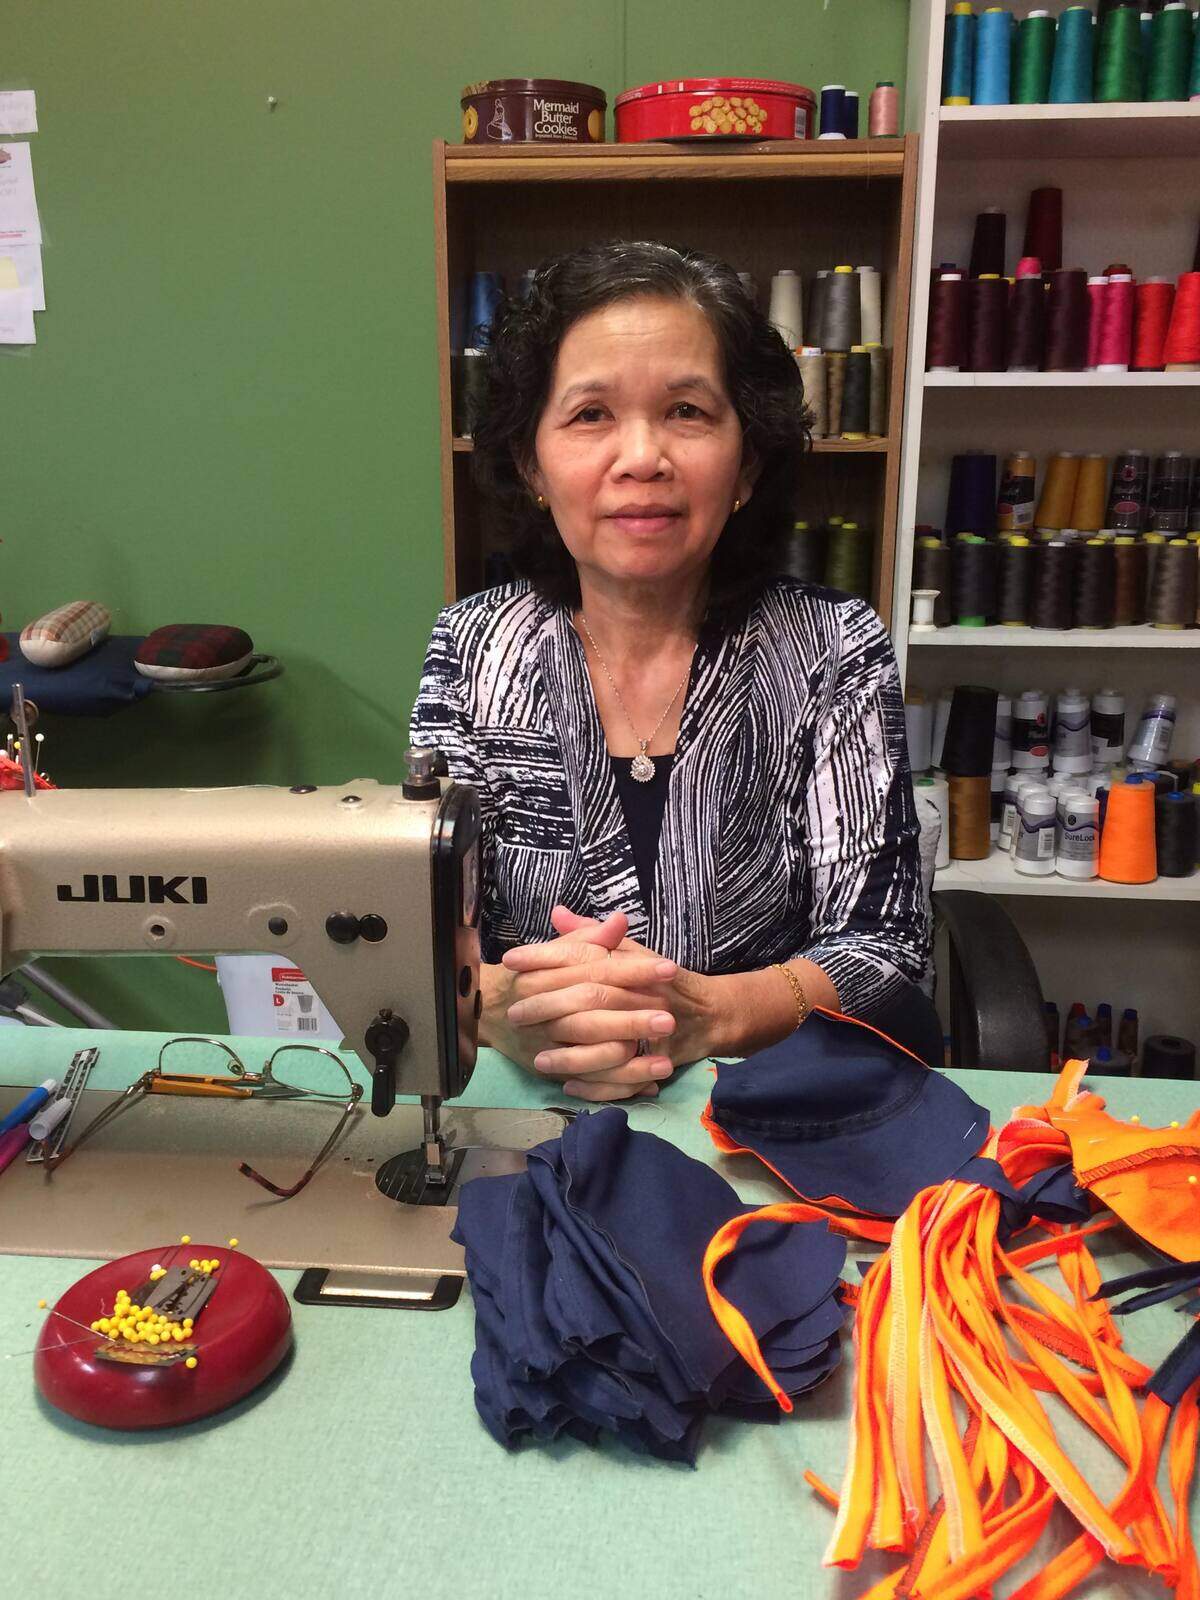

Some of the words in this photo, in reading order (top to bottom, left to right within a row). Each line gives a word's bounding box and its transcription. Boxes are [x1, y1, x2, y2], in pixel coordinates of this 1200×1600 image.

[534, 99, 579, 114] Mermaid
[542, 110, 573, 124] Butter
[534, 121, 578, 136] Cookies
[57, 874, 208, 904] JUKI
